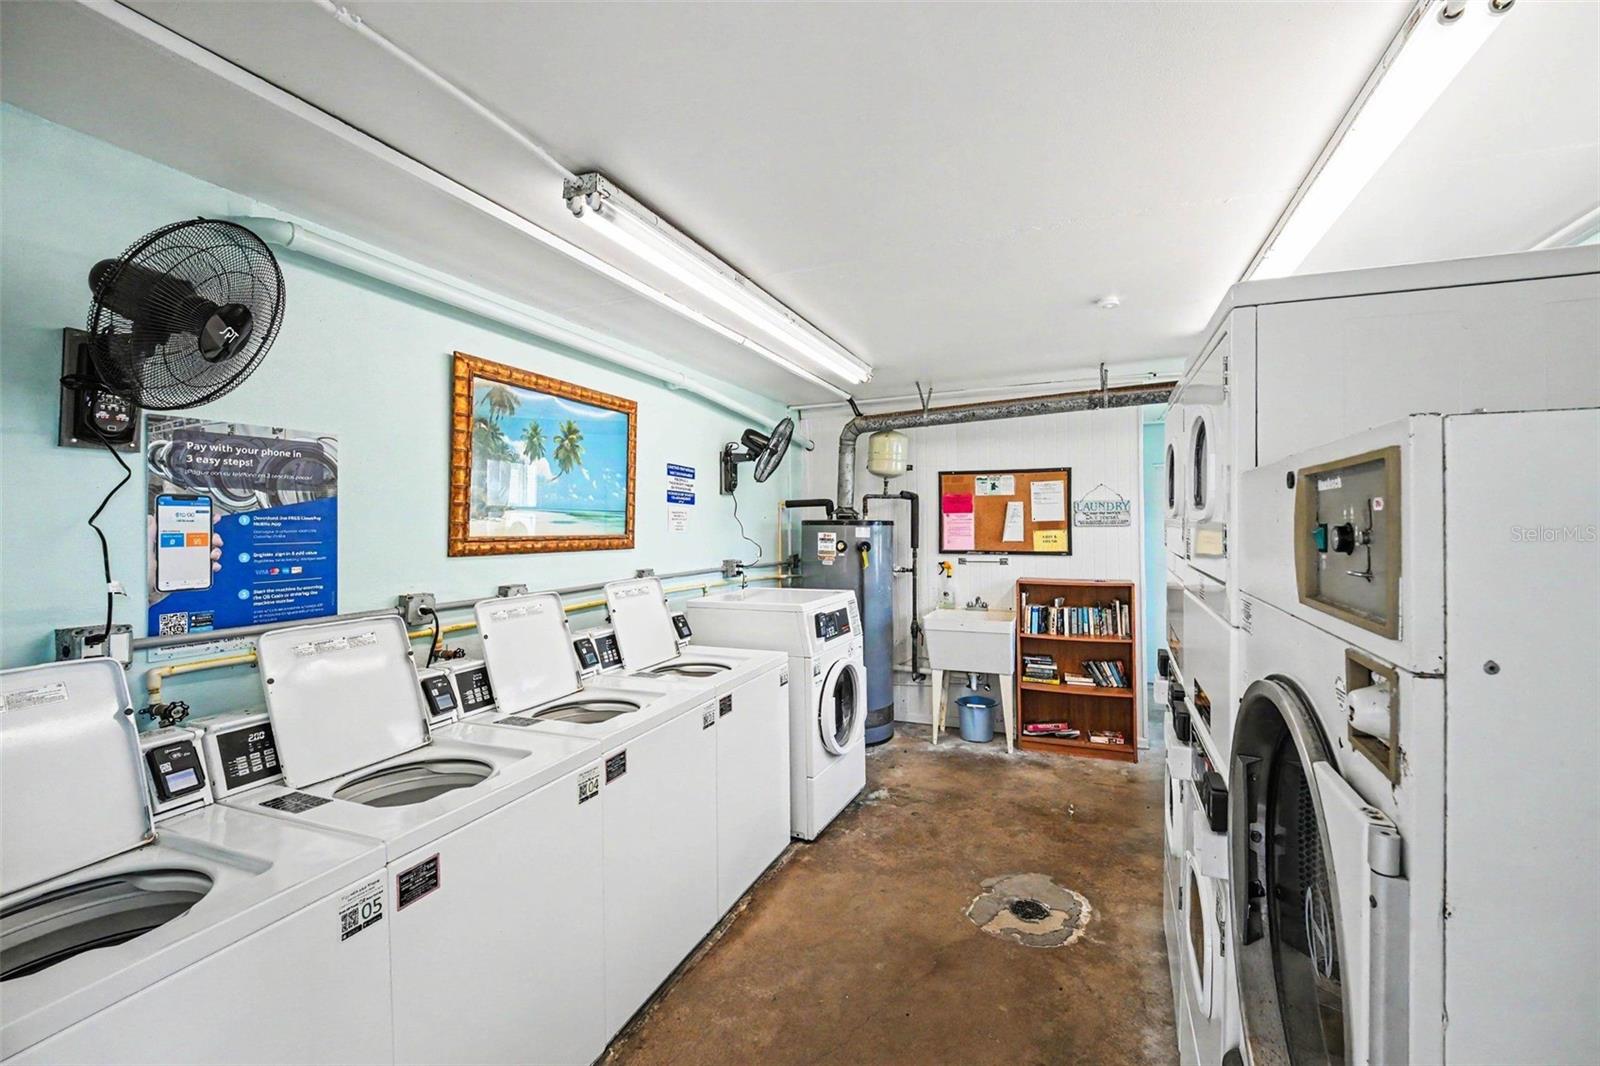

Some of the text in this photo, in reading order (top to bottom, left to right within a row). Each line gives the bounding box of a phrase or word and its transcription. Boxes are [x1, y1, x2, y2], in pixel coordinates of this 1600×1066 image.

[219, 326, 240, 344] SPT
[186, 441, 302, 458] Pay with your phone in
[186, 454, 254, 468] 3 easy steps!
[1077, 499, 1130, 511] LAUNDRY
[361, 896, 382, 919] 05
